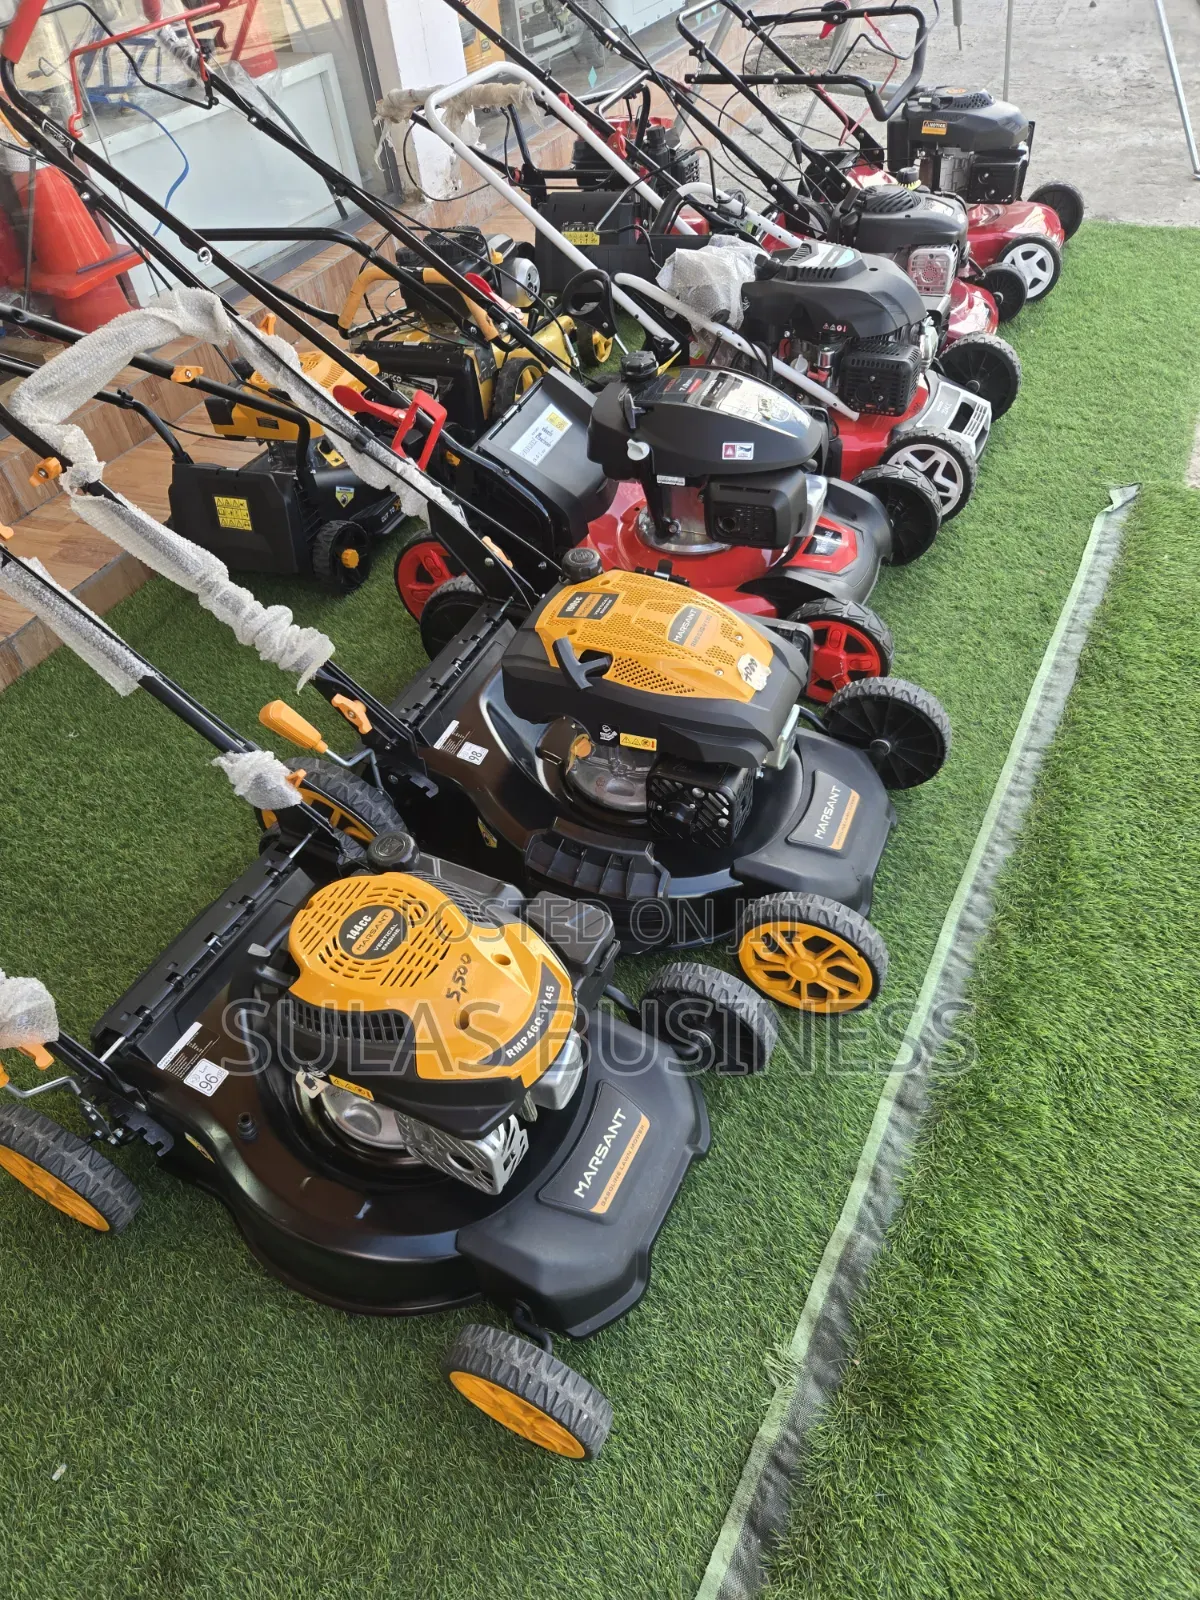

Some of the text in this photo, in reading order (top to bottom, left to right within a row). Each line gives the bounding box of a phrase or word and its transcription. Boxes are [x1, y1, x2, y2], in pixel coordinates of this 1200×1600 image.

[673, 608, 697, 642] MARSANT
[468, 750, 483, 761] 98
[814, 785, 841, 840] MARSANT
[346, 914, 372, 940] 144cc
[357, 912, 389, 951] MARSANT
[373, 923, 399, 951] VERTICAL
[381, 928, 401, 951] ENGINE
[445, 952, 472, 1003] 5,500
[198, 1073, 219, 1092] 96
[573, 1107, 627, 1199] MARSANT
